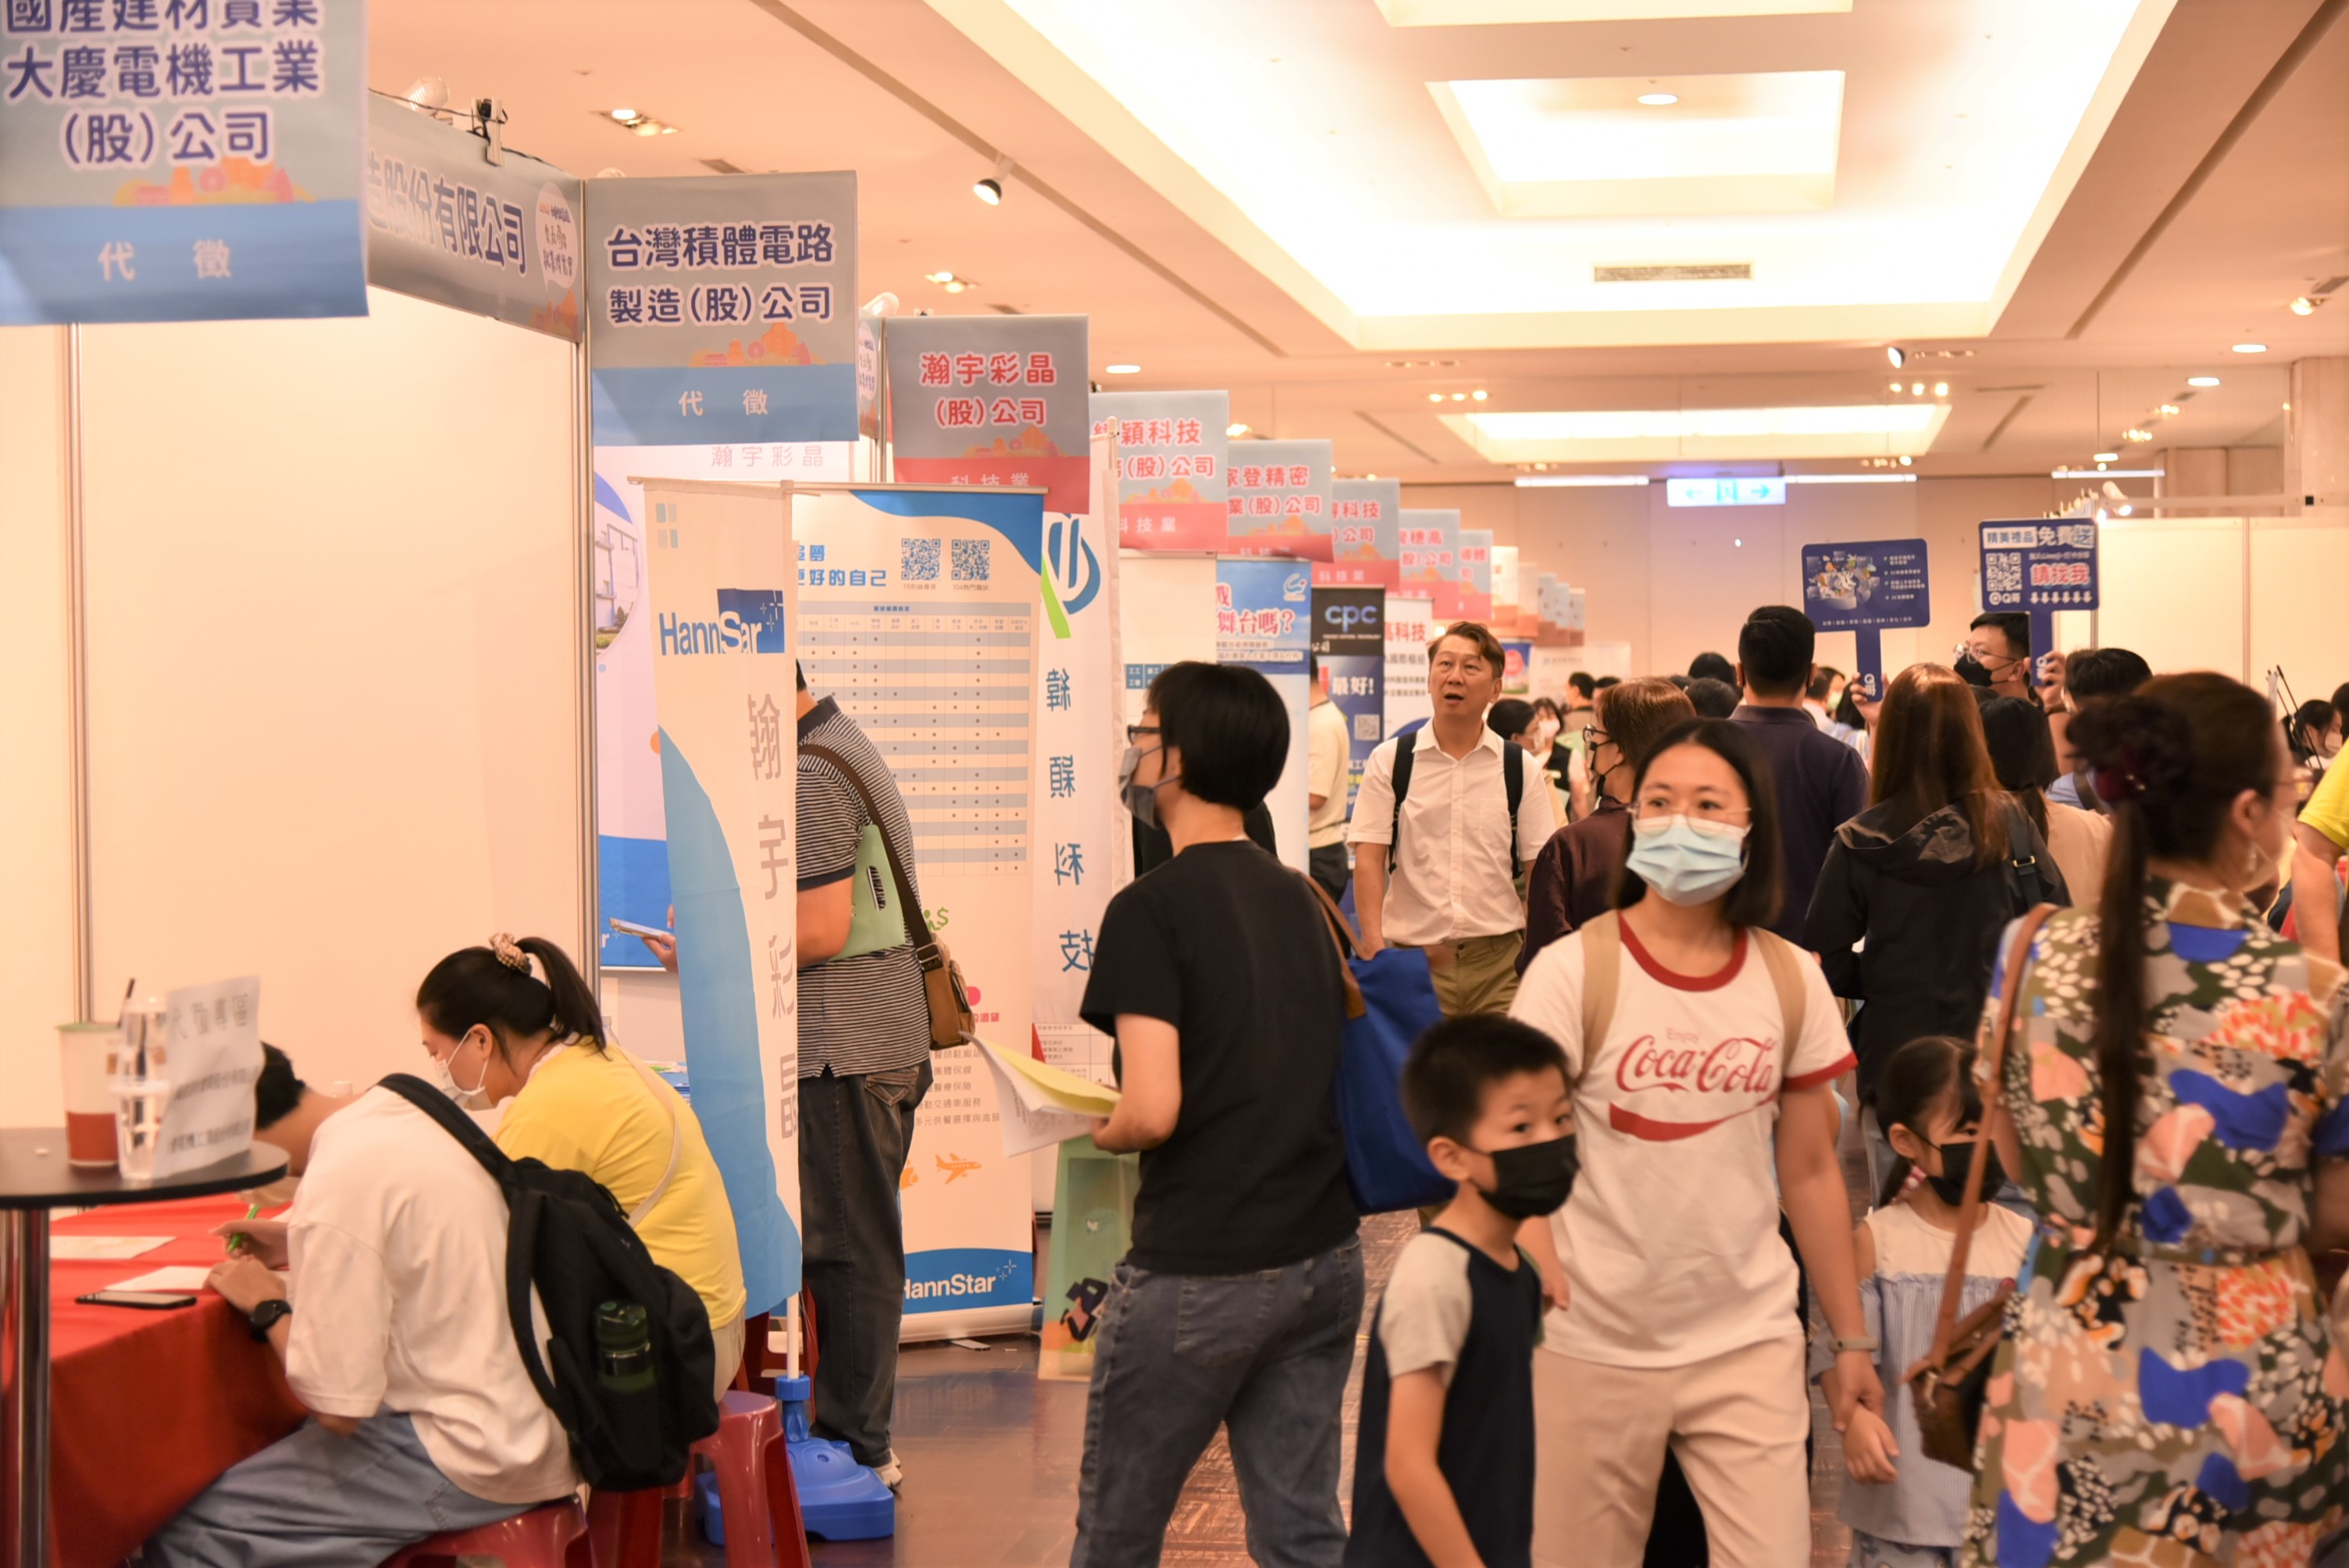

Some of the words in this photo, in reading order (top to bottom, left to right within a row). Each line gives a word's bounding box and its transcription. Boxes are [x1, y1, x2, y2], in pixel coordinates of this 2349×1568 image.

[7, 40, 319, 98] 大慶電機工業
[65, 112, 269, 164] (股)公司
[607, 224, 835, 268] 台灣積體電路
[609, 285, 832, 323] 製造(股)公司
[921, 352, 1057, 385] 瀚宇彩晶
[936, 396, 1046, 426] (股)公司
[711, 445, 823, 467] 瀚宇彩晶
[1117, 456, 1214, 479] (股)公司
[2032, 563, 2090, 585] 請找我
[659, 611, 762, 655] HannSar
[1325, 605, 1378, 633] cpc
